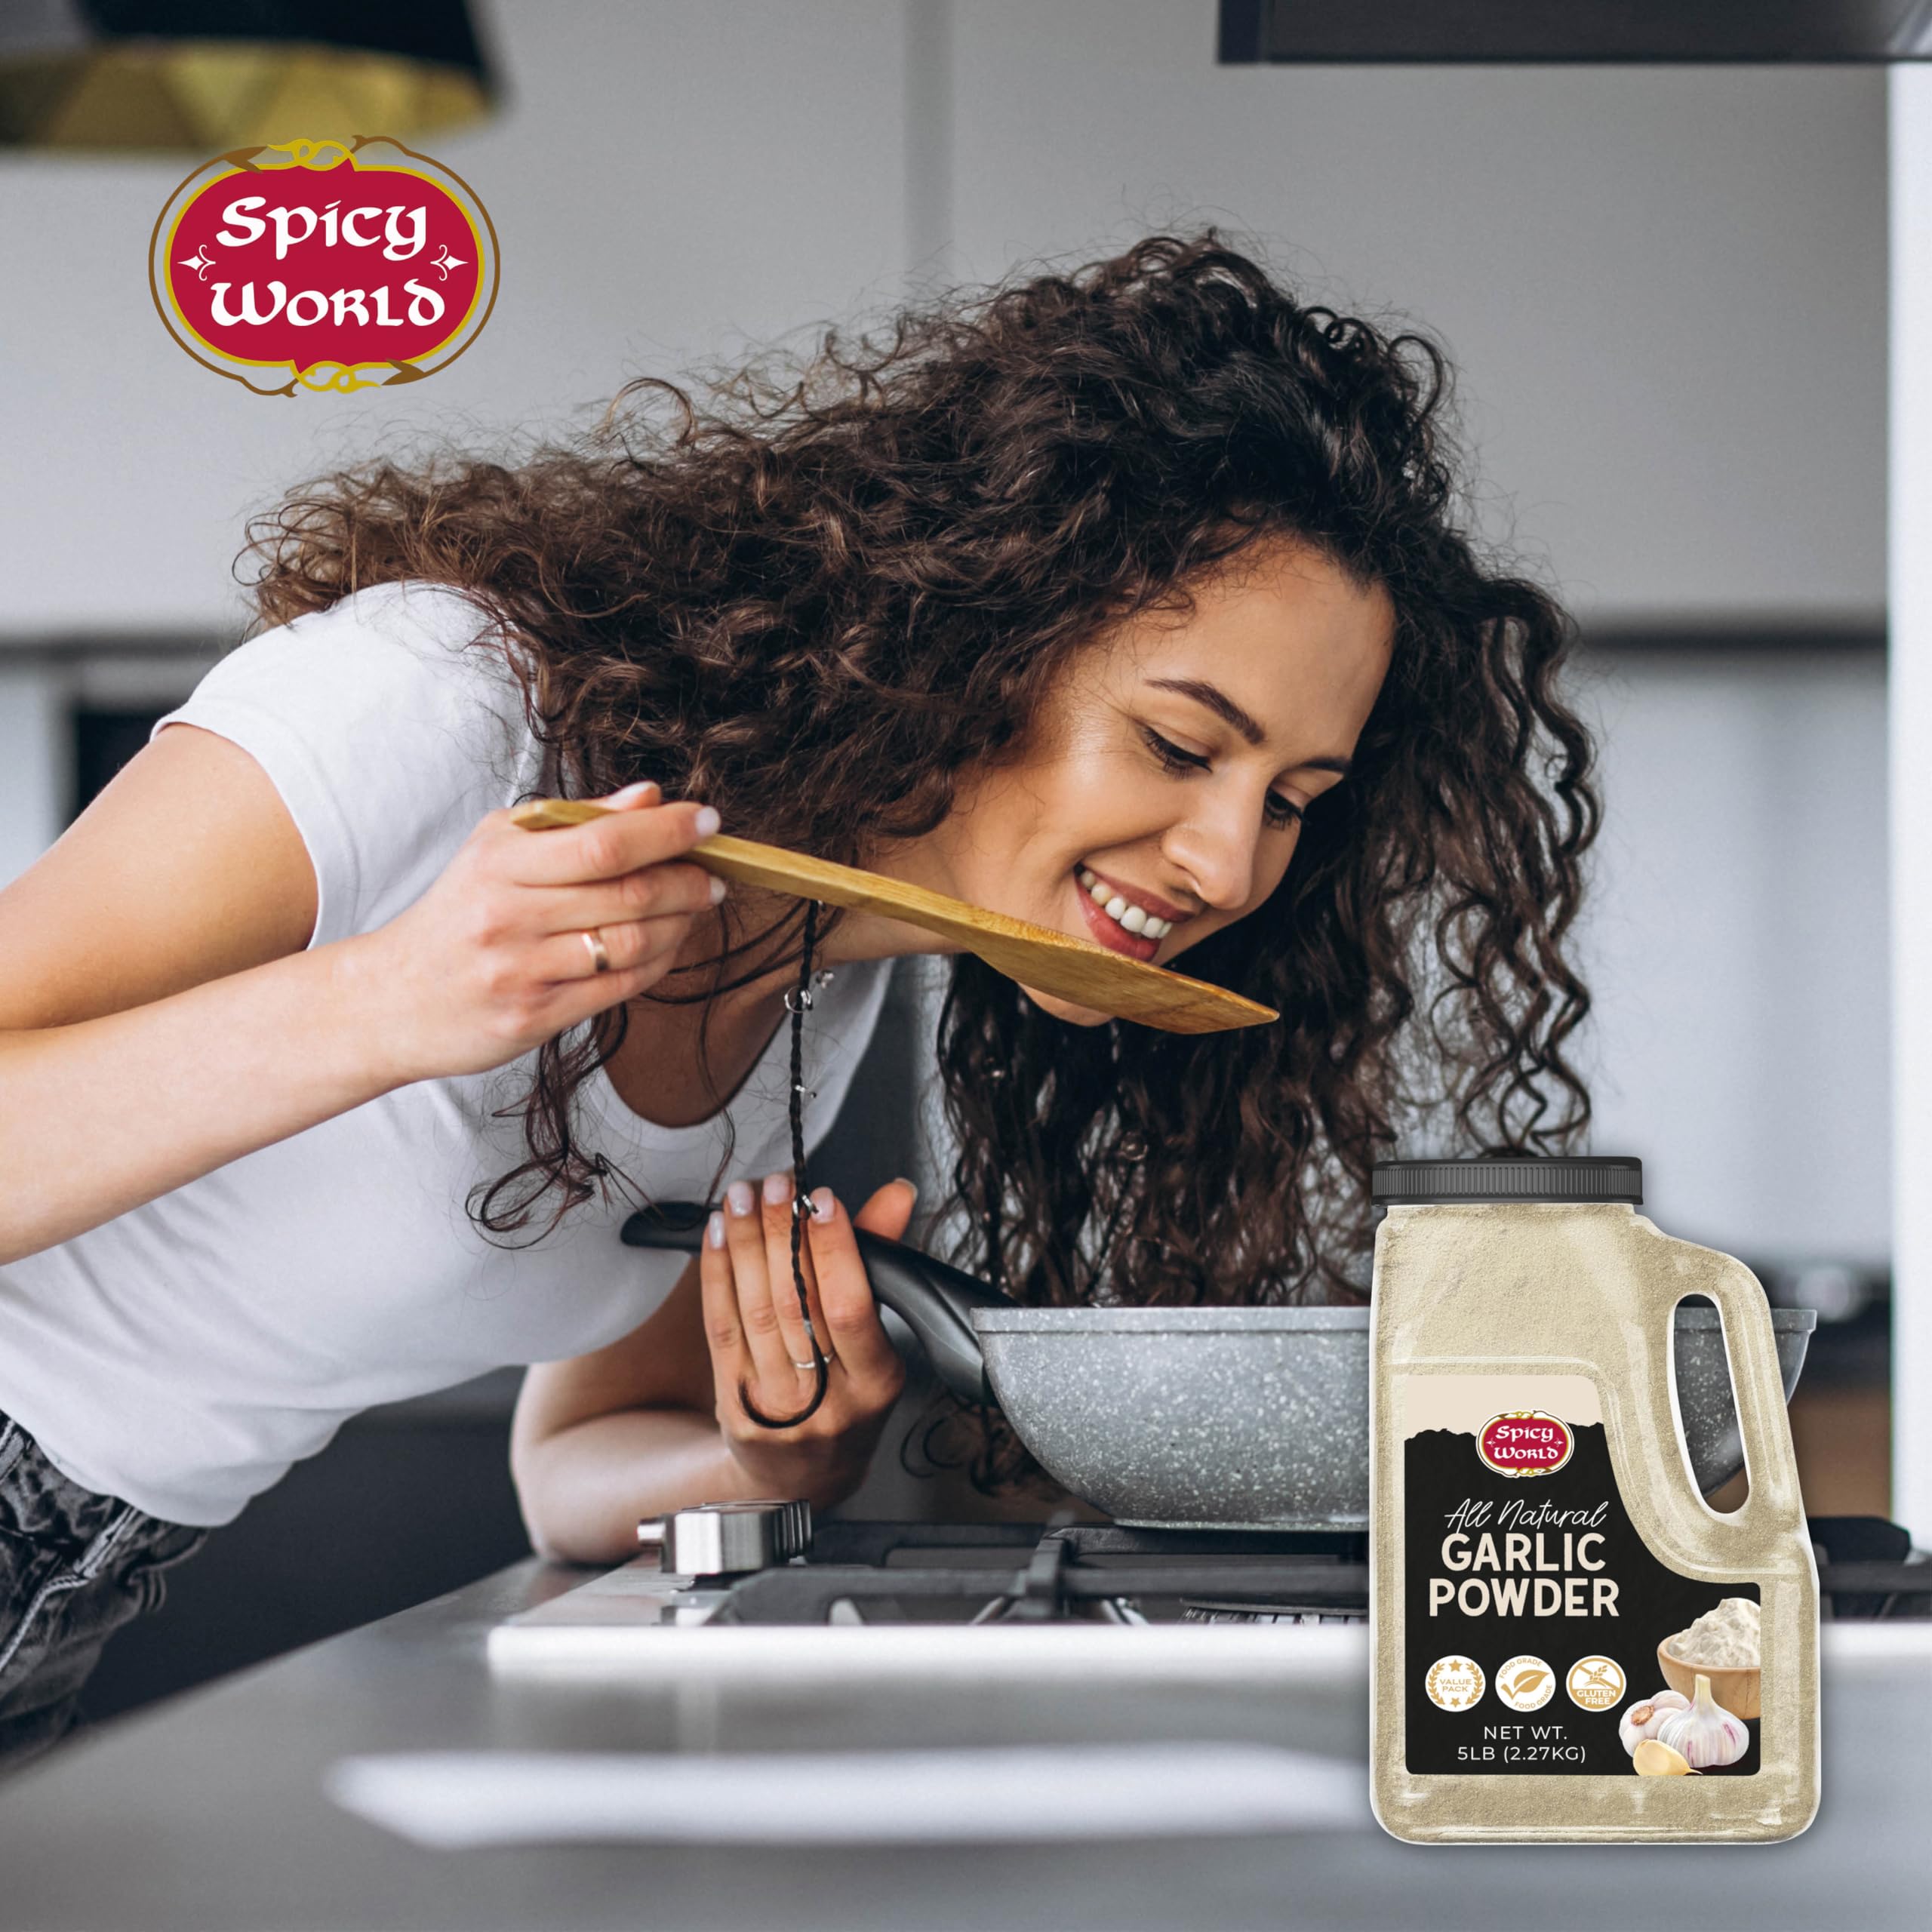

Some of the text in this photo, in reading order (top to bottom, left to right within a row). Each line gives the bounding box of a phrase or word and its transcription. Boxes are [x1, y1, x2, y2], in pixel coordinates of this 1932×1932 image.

[1495, 1426, 1553, 1442] Spicy
[1444, 1498, 1609, 1534] All Natural
[1441, 1532, 1606, 1572] GARLIC
[1429, 1578, 1620, 1617] POWDER
[1498, 1657, 1543, 1679] FOOD GRADE
[1514, 1684, 1552, 1709] FOOD GRADE
[1484, 1726, 1567, 1740] NET WT.
[1457, 1746, 1586, 1764] 5LB (2.27KG)
